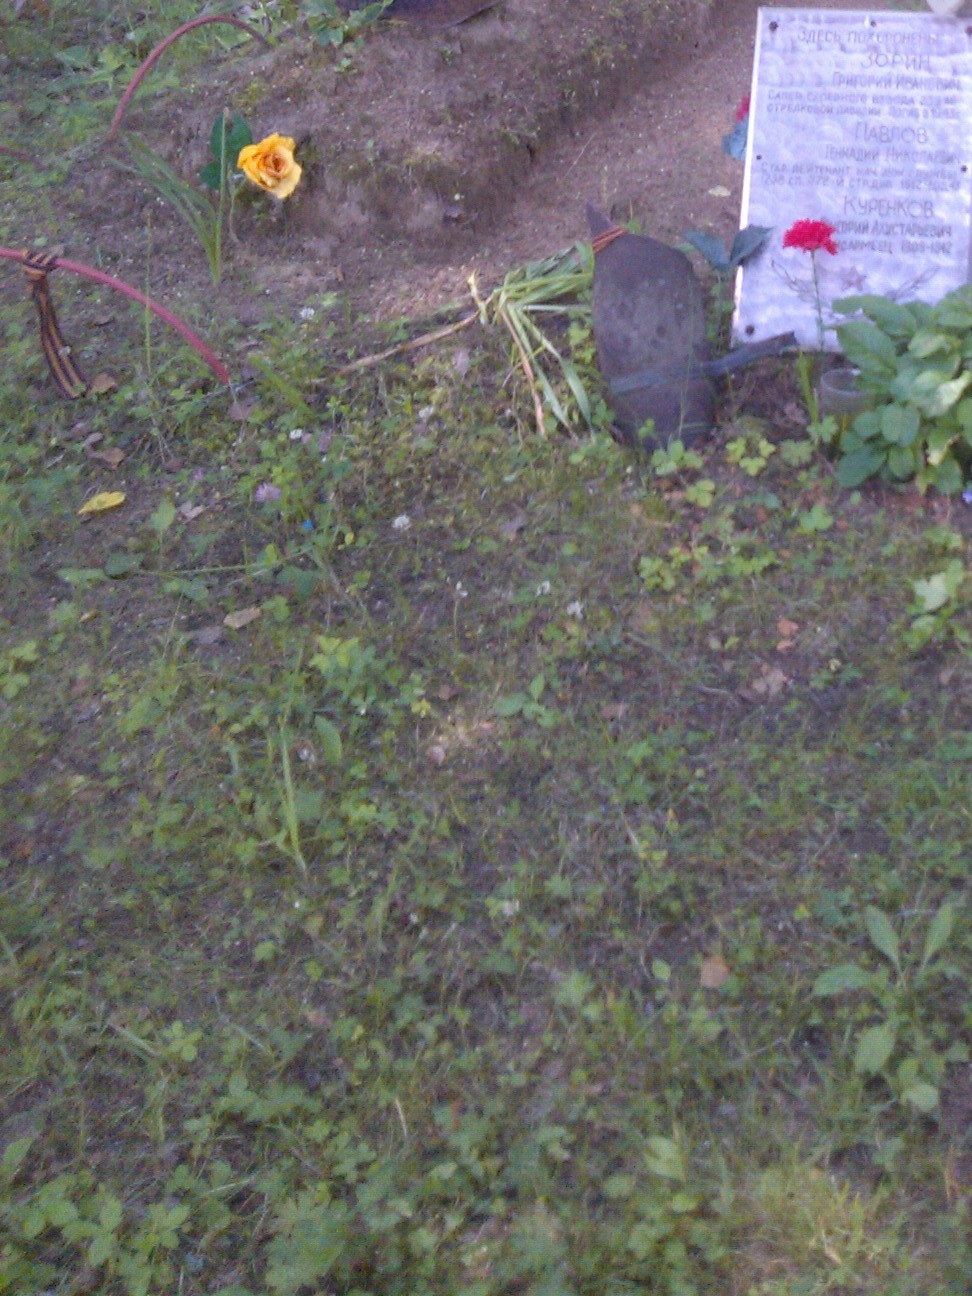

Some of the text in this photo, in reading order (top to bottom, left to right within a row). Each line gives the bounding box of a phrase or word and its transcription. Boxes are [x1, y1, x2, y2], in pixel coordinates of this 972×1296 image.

[797, 29, 841, 43] ЗДЕСЬ
[860, 52, 931, 70] ЗОРИН
[832, 72, 892, 88] ГРИГОРИЙ
[854, 121, 929, 144] ПАВЛОВ
[824, 144, 880, 161] ГЕННАДИЙ
[843, 196, 934, 218] КУРЕНКОВ
